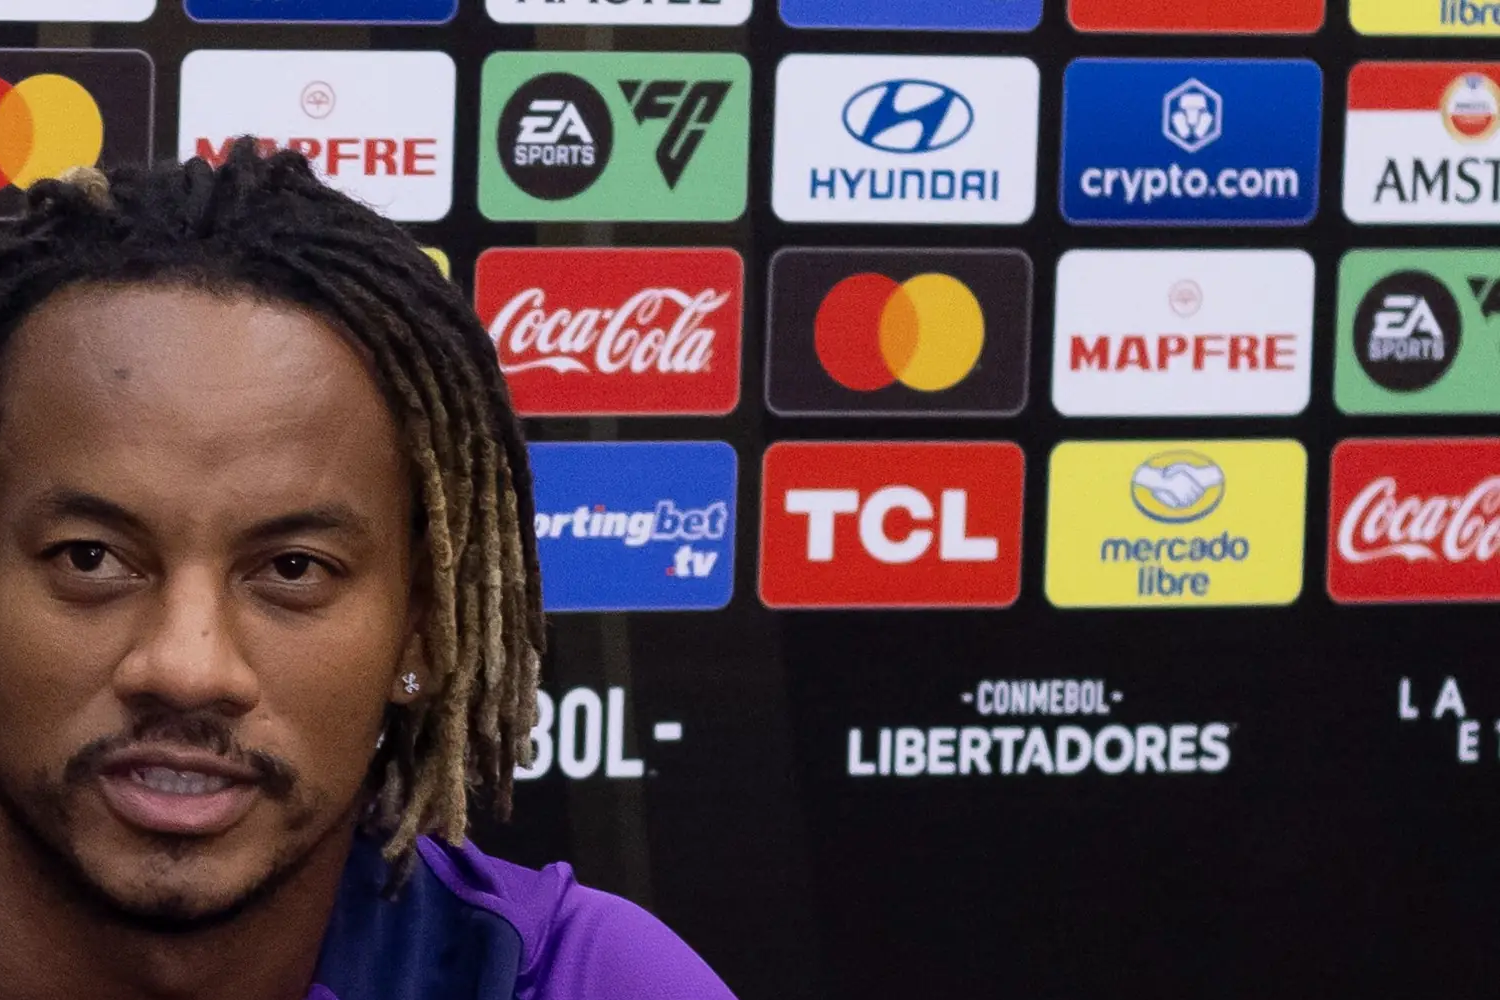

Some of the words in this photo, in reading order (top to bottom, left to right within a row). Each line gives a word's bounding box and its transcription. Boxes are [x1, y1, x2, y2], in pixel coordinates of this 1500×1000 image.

[515, 99, 593, 144] EA
[514, 144, 595, 168] SPORTS
[809, 168, 1000, 202] HYUNDAI
[1079, 163, 1300, 204] crypto.com
[488, 287, 732, 375] Coca-Cola
[1373, 293, 1444, 338] EA
[1069, 332, 1298, 372] MAPFRE
[785, 485, 999, 564] TCL
[1101, 531, 1250, 564] mercado
[1137, 566, 1210, 597] libre
[846, 721, 1232, 777] LIBERTADORES
